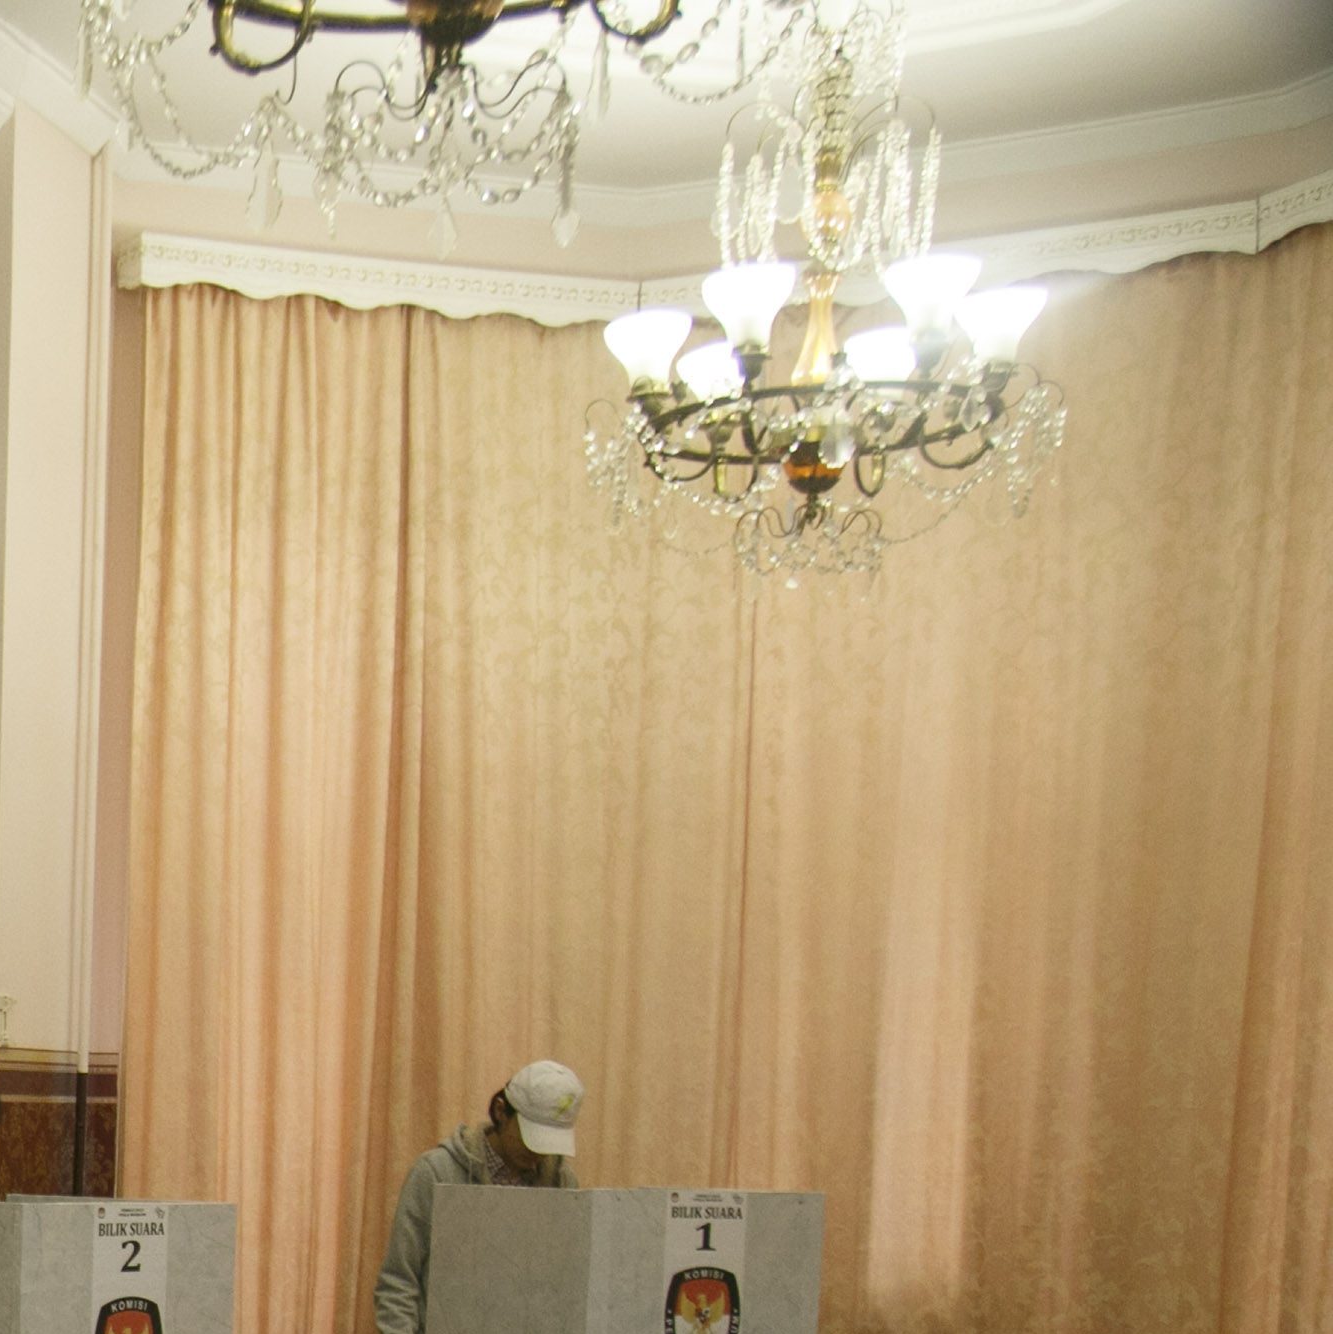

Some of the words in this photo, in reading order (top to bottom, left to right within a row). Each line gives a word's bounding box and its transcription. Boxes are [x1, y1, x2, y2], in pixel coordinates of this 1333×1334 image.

[671, 1206, 703, 1219] BILIK
[705, 1206, 743, 1220] SUARA
[98, 1223, 128, 1237] BILIK
[130, 1222, 165, 1236] SUARA
[695, 1222, 717, 1251] 1
[120, 1240, 141, 1272] 2
[684, 1270, 725, 1281] KOMISI
[111, 1299, 148, 1312] KOMISI
